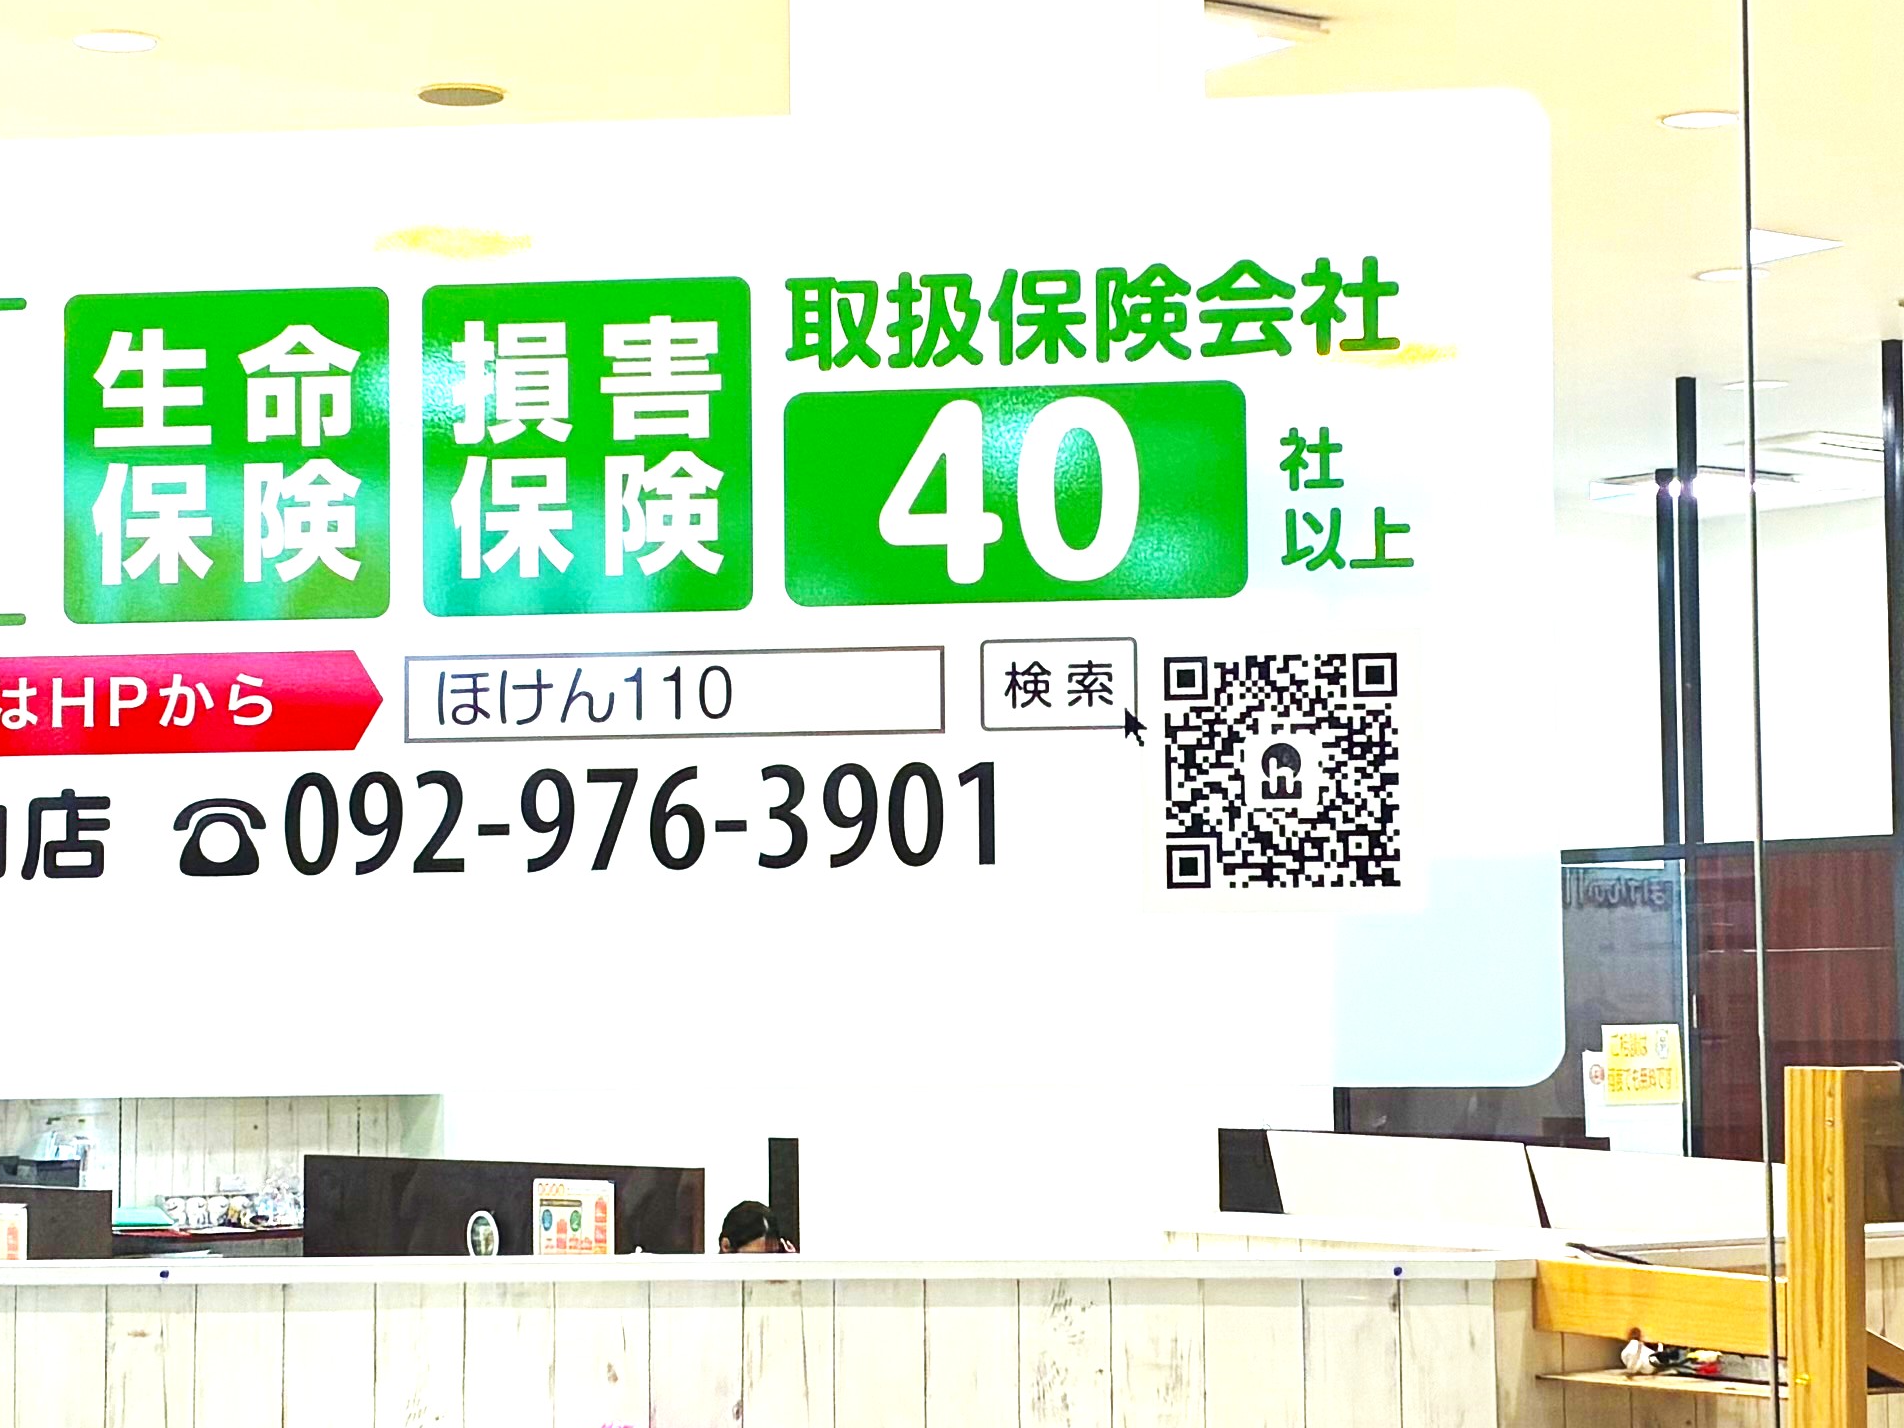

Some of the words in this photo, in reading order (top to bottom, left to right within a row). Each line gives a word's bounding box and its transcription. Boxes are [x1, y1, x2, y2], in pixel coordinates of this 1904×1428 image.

[784, 255, 1400, 370] 取扱保険会社
[93, 324, 362, 448] 生命
[450, 314, 723, 444] 損害
[448, 451, 725, 580] 保険
[878, 394, 1142, 585] 40
[1279, 426, 1346, 492] 社
[91, 458, 363, 586] 保険
[1280, 506, 1415, 572] 以上
[436, 664, 734, 727] ほけん110
[1004, 659, 1115, 709] 検索
[283, 761, 997, 876] 092-976-3901
